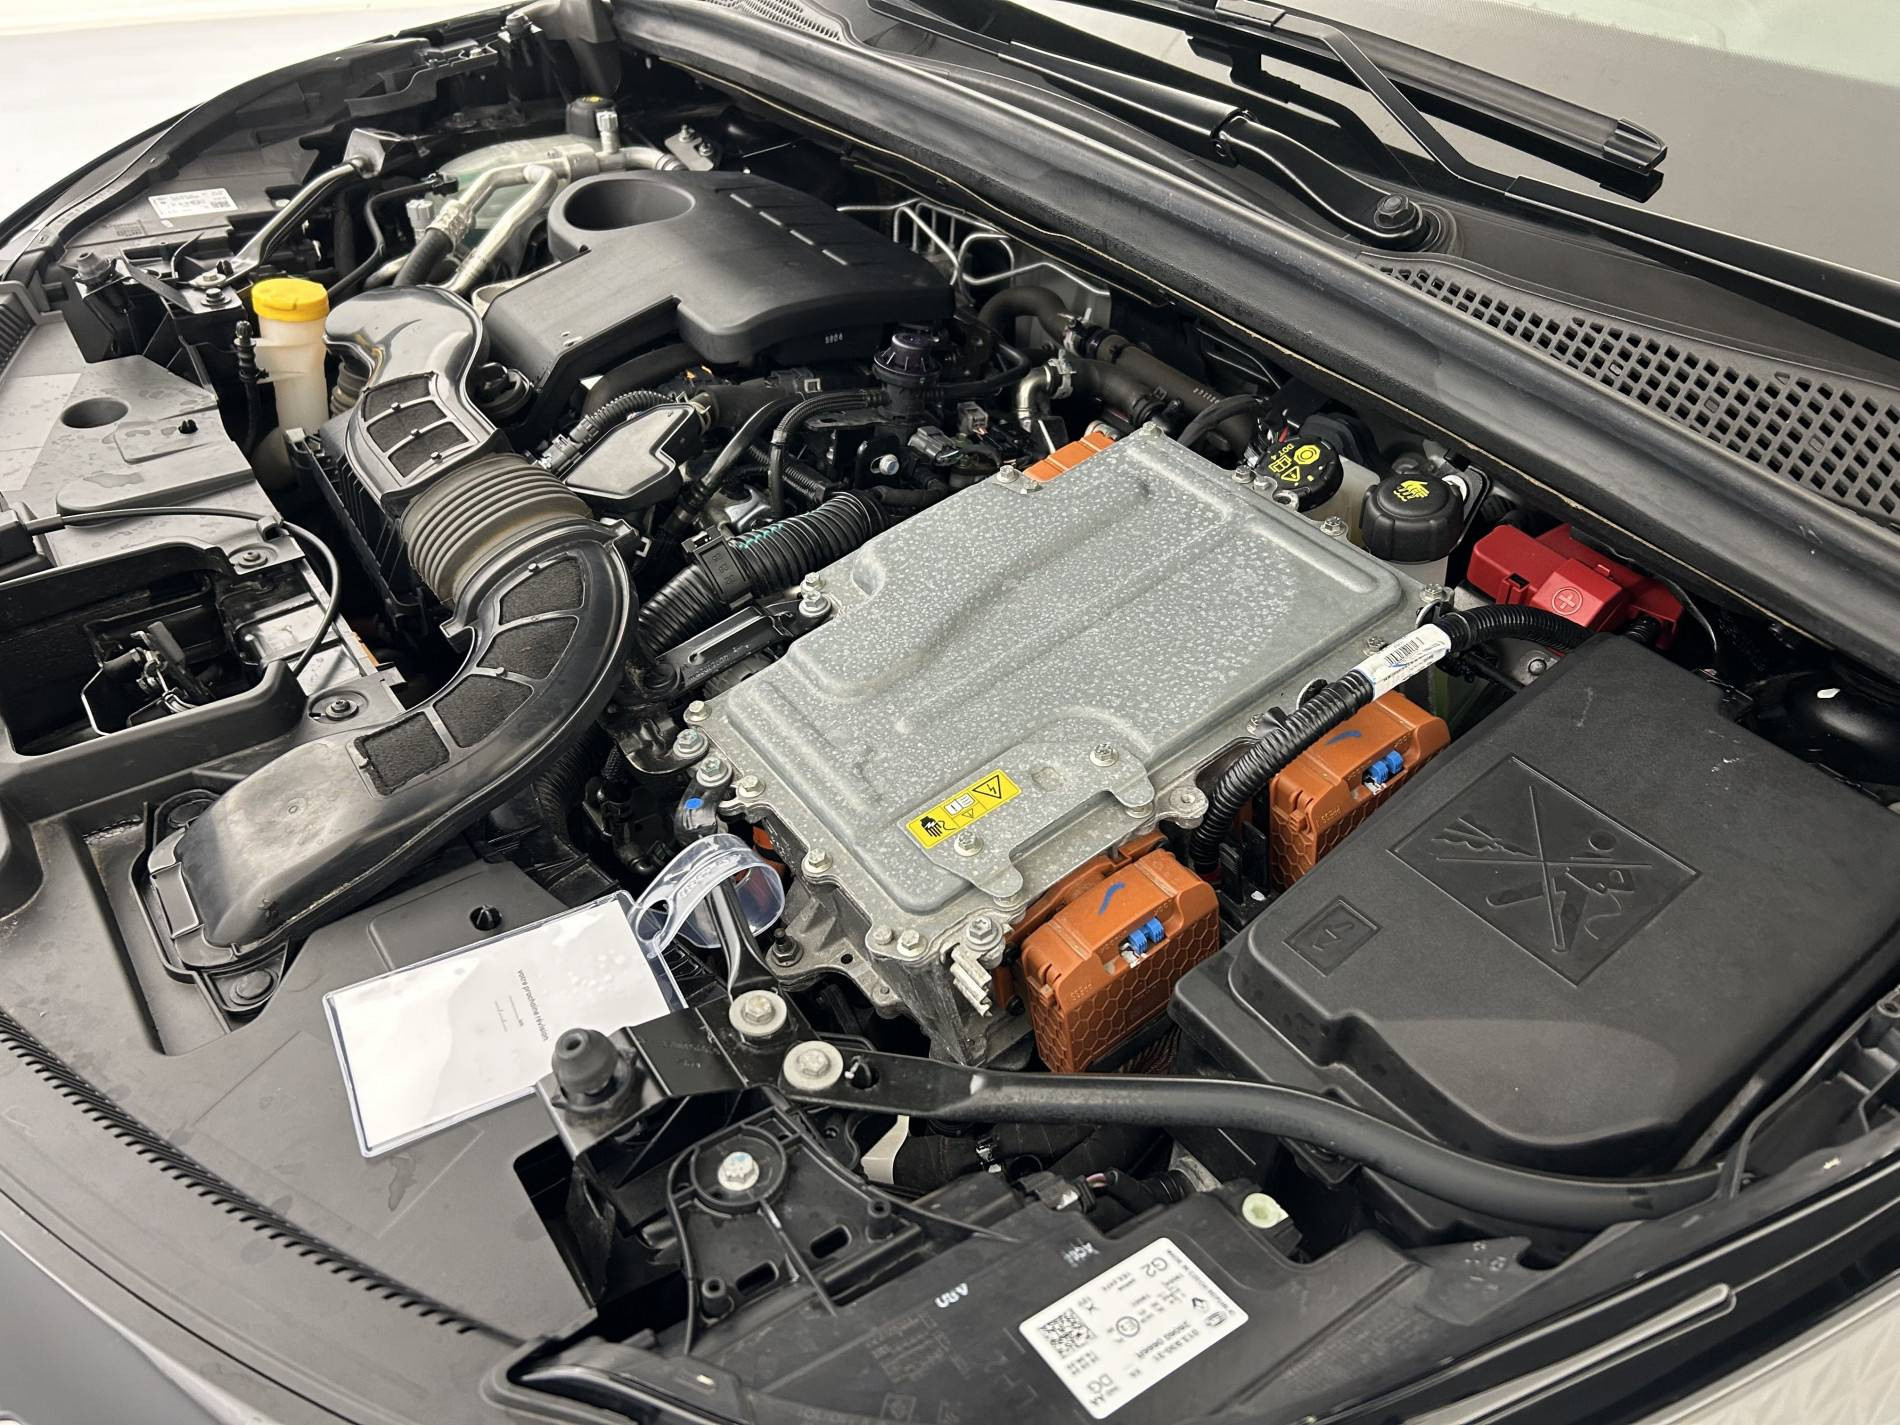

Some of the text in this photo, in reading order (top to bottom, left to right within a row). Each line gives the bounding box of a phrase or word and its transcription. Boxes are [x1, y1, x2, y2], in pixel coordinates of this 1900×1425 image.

[1278, 443, 1294, 457] DOT
[518, 969, 549, 1041] votre prochaine révision
[1142, 1256, 1168, 1277] G2
[1087, 1373, 1114, 1394] DG
